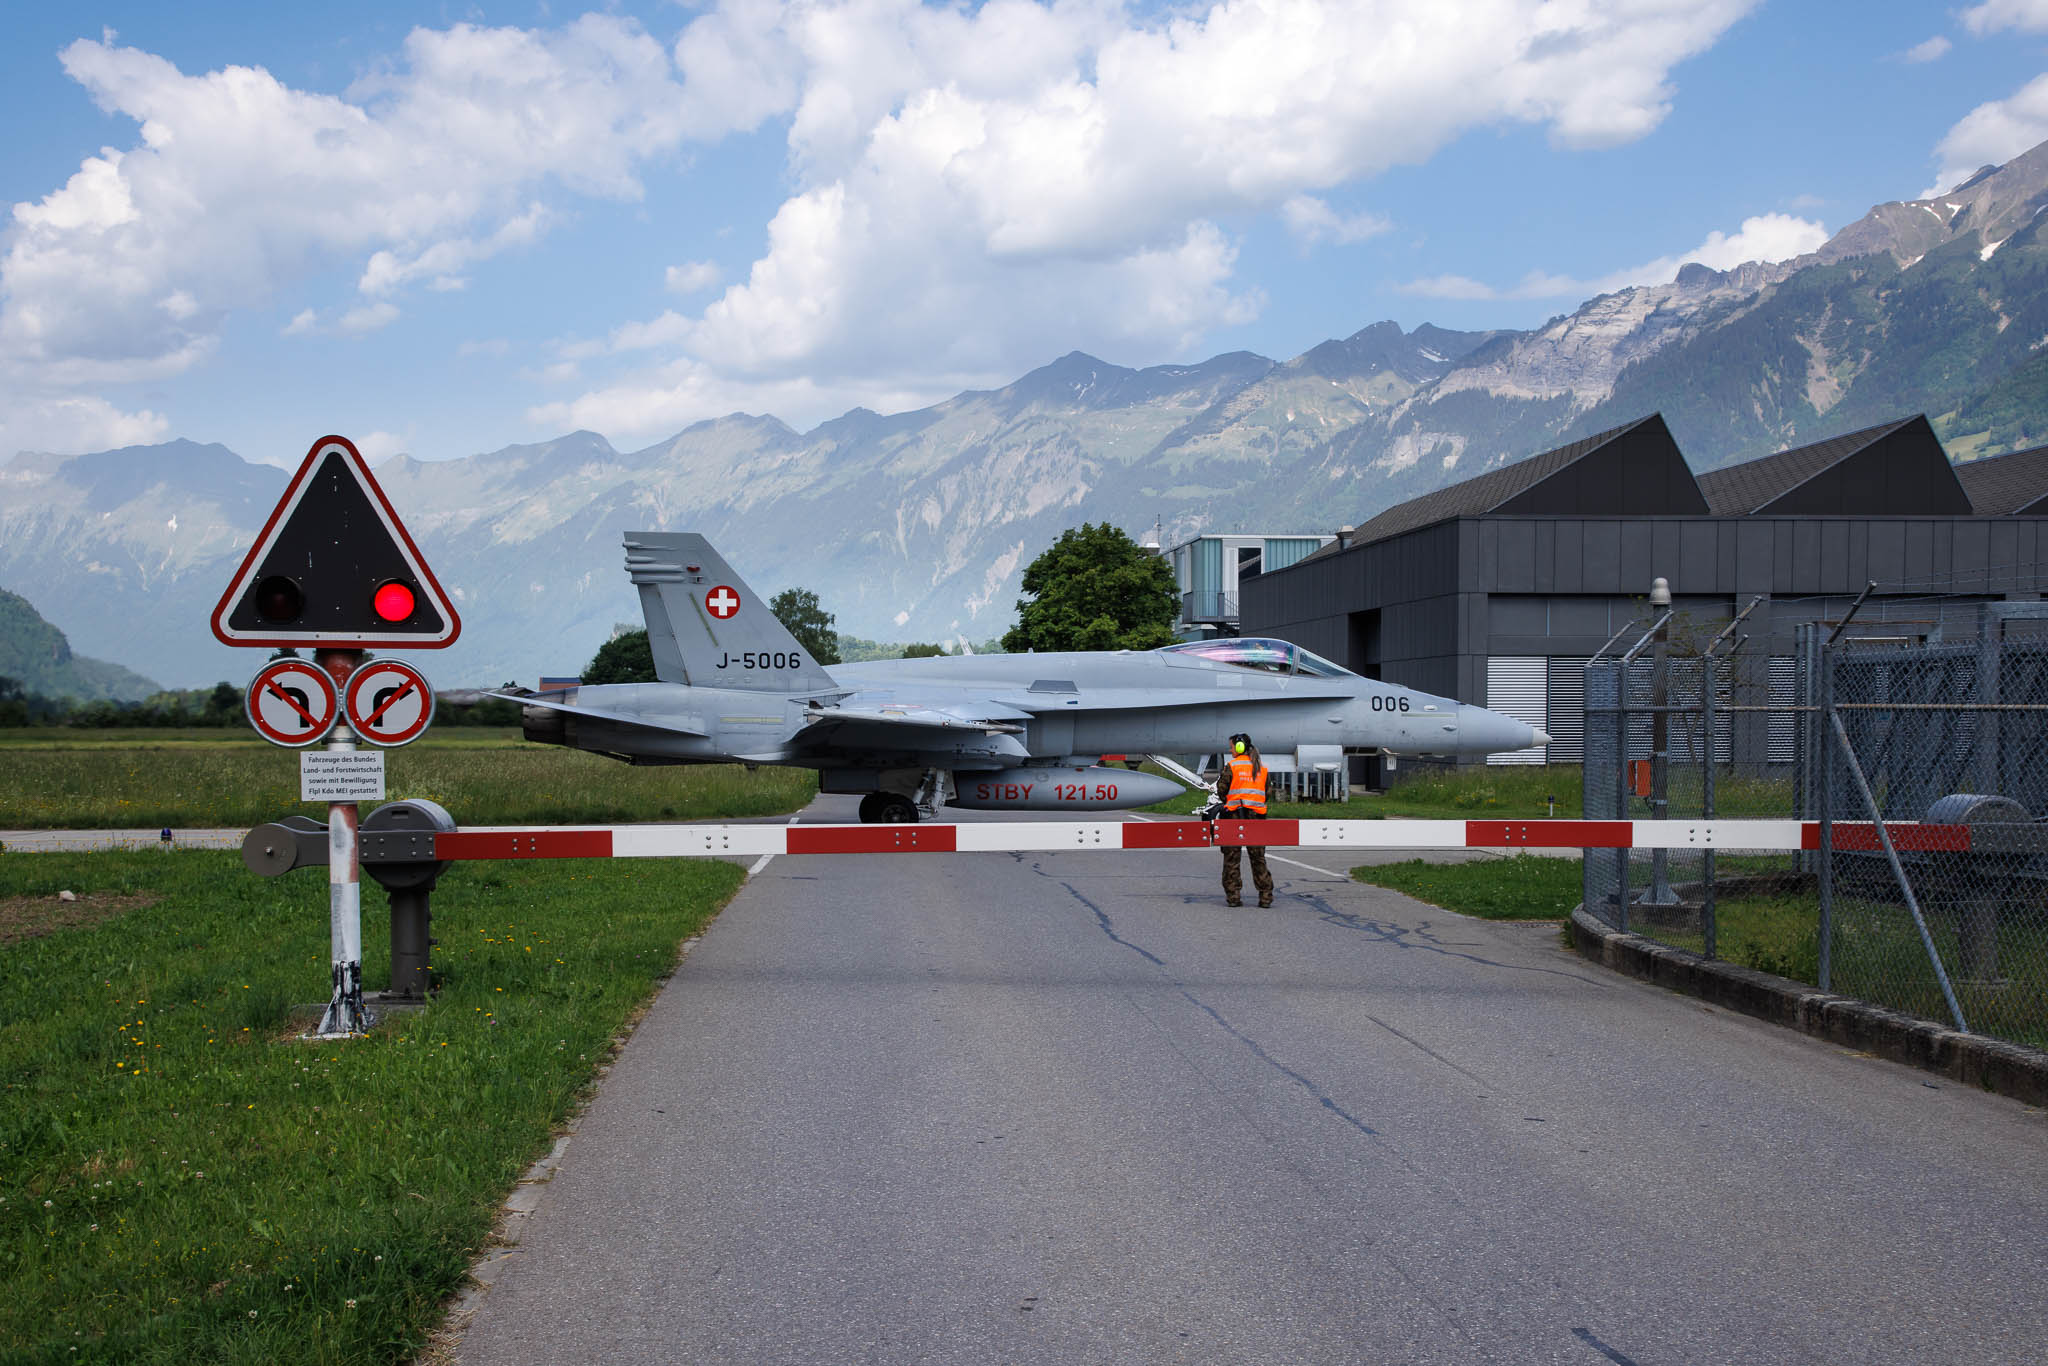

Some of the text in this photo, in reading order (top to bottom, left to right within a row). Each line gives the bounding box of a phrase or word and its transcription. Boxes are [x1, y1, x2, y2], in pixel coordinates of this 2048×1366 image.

[716, 652, 801, 669] J-5006
[1371, 696, 1410, 712] 006
[308, 756, 340, 764] Fahrzeuge
[341, 777, 377, 785] Bewilligung
[349, 787, 378, 795] gestattet
[975, 783, 1118, 801] STBY 121.50
